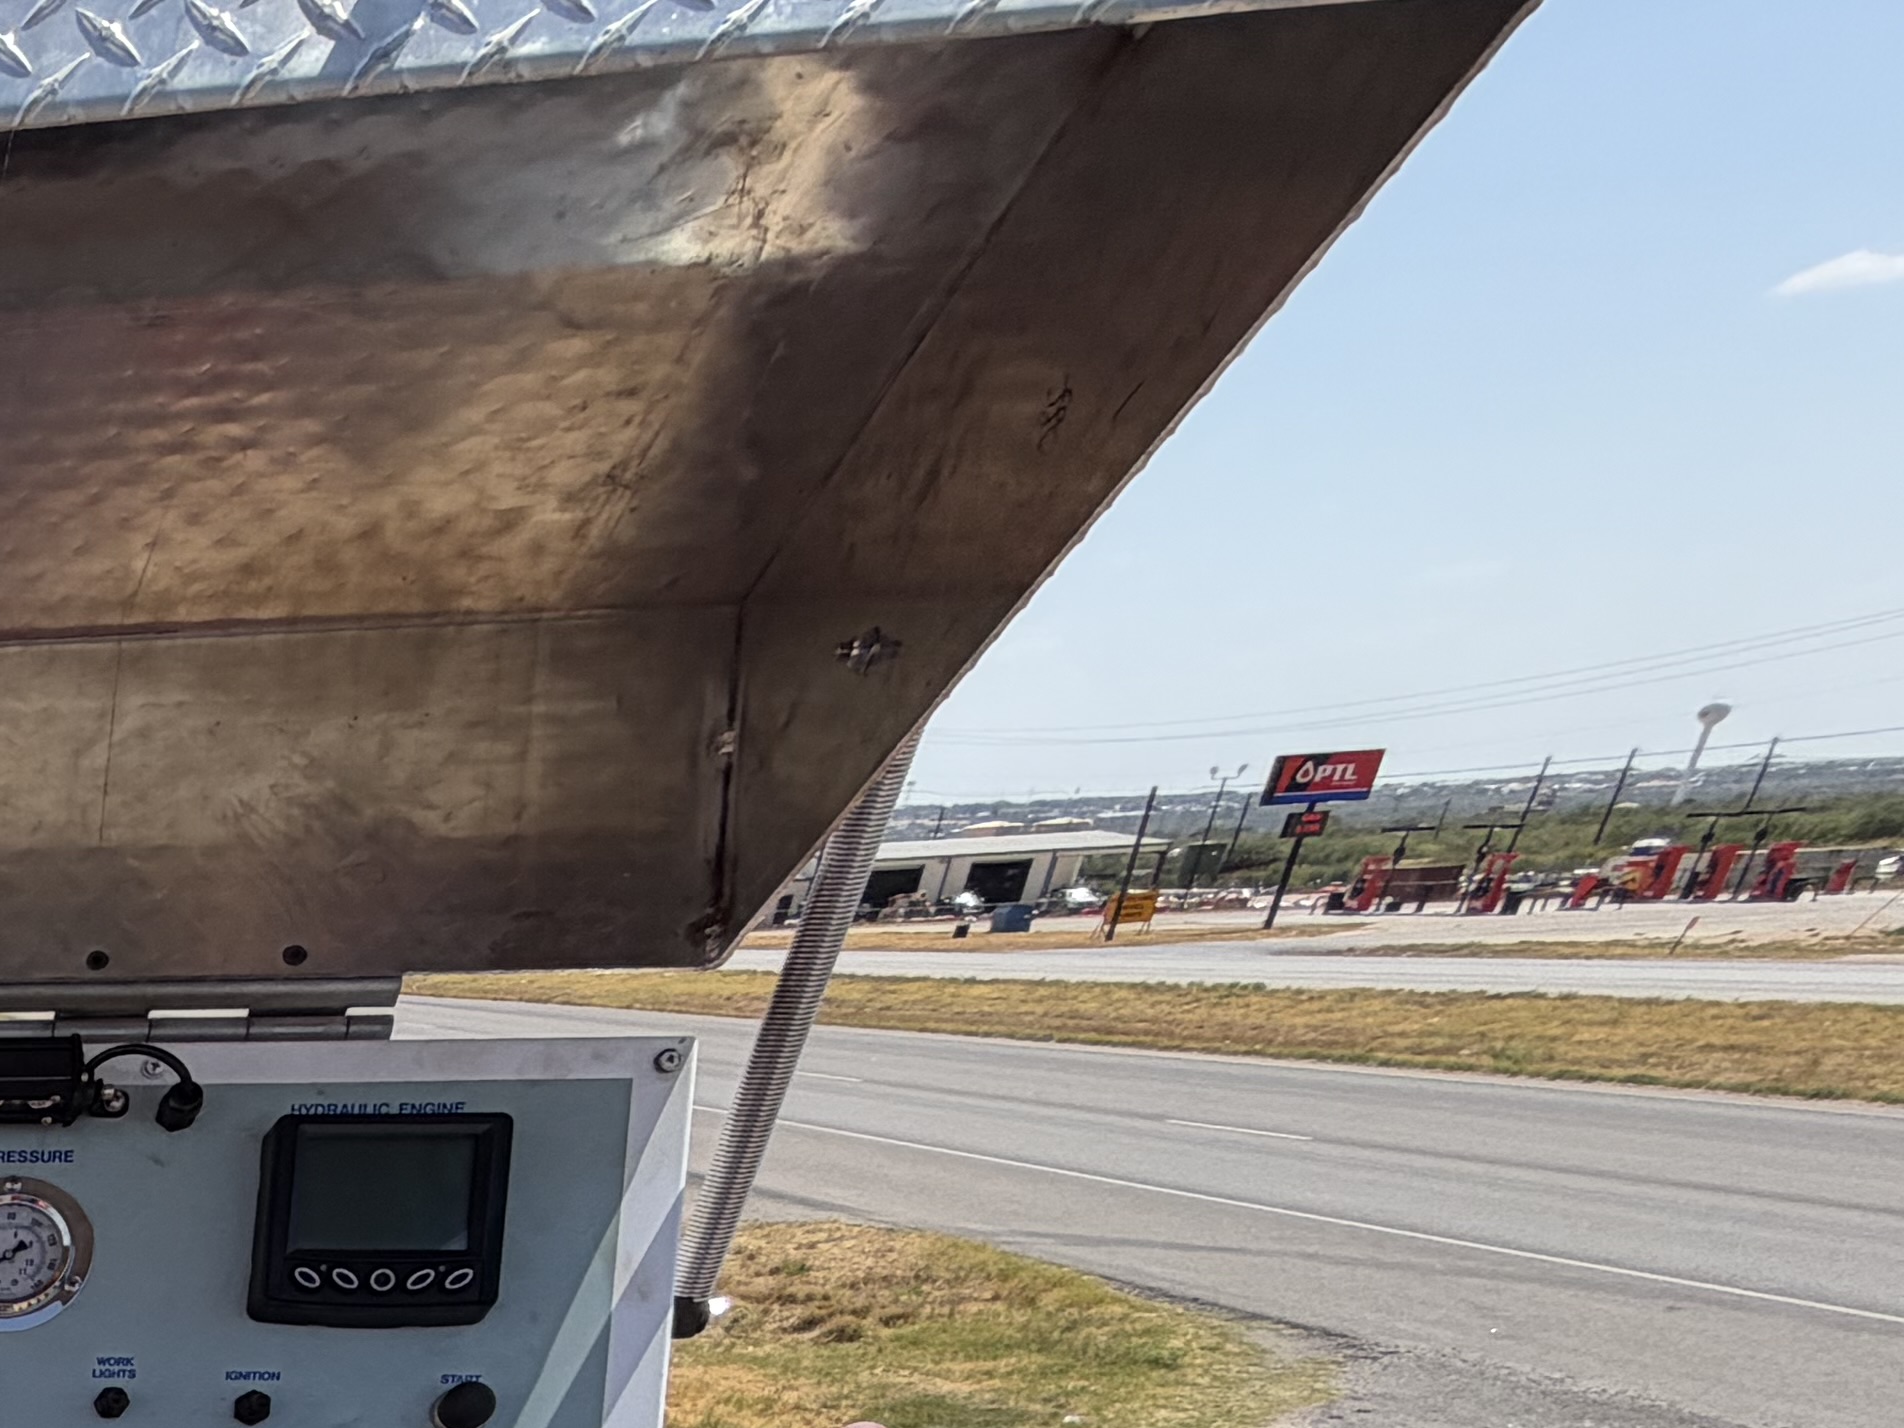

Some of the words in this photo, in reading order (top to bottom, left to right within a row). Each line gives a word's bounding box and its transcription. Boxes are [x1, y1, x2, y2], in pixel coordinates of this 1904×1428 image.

[291, 1102, 390, 1115] HYDRAULIC
[399, 1102, 466, 1114] ENGINE
[96, 1357, 134, 1367] WORK
[92, 1369, 136, 1379] LIGHTS
[225, 1371, 281, 1381] IGNITION
